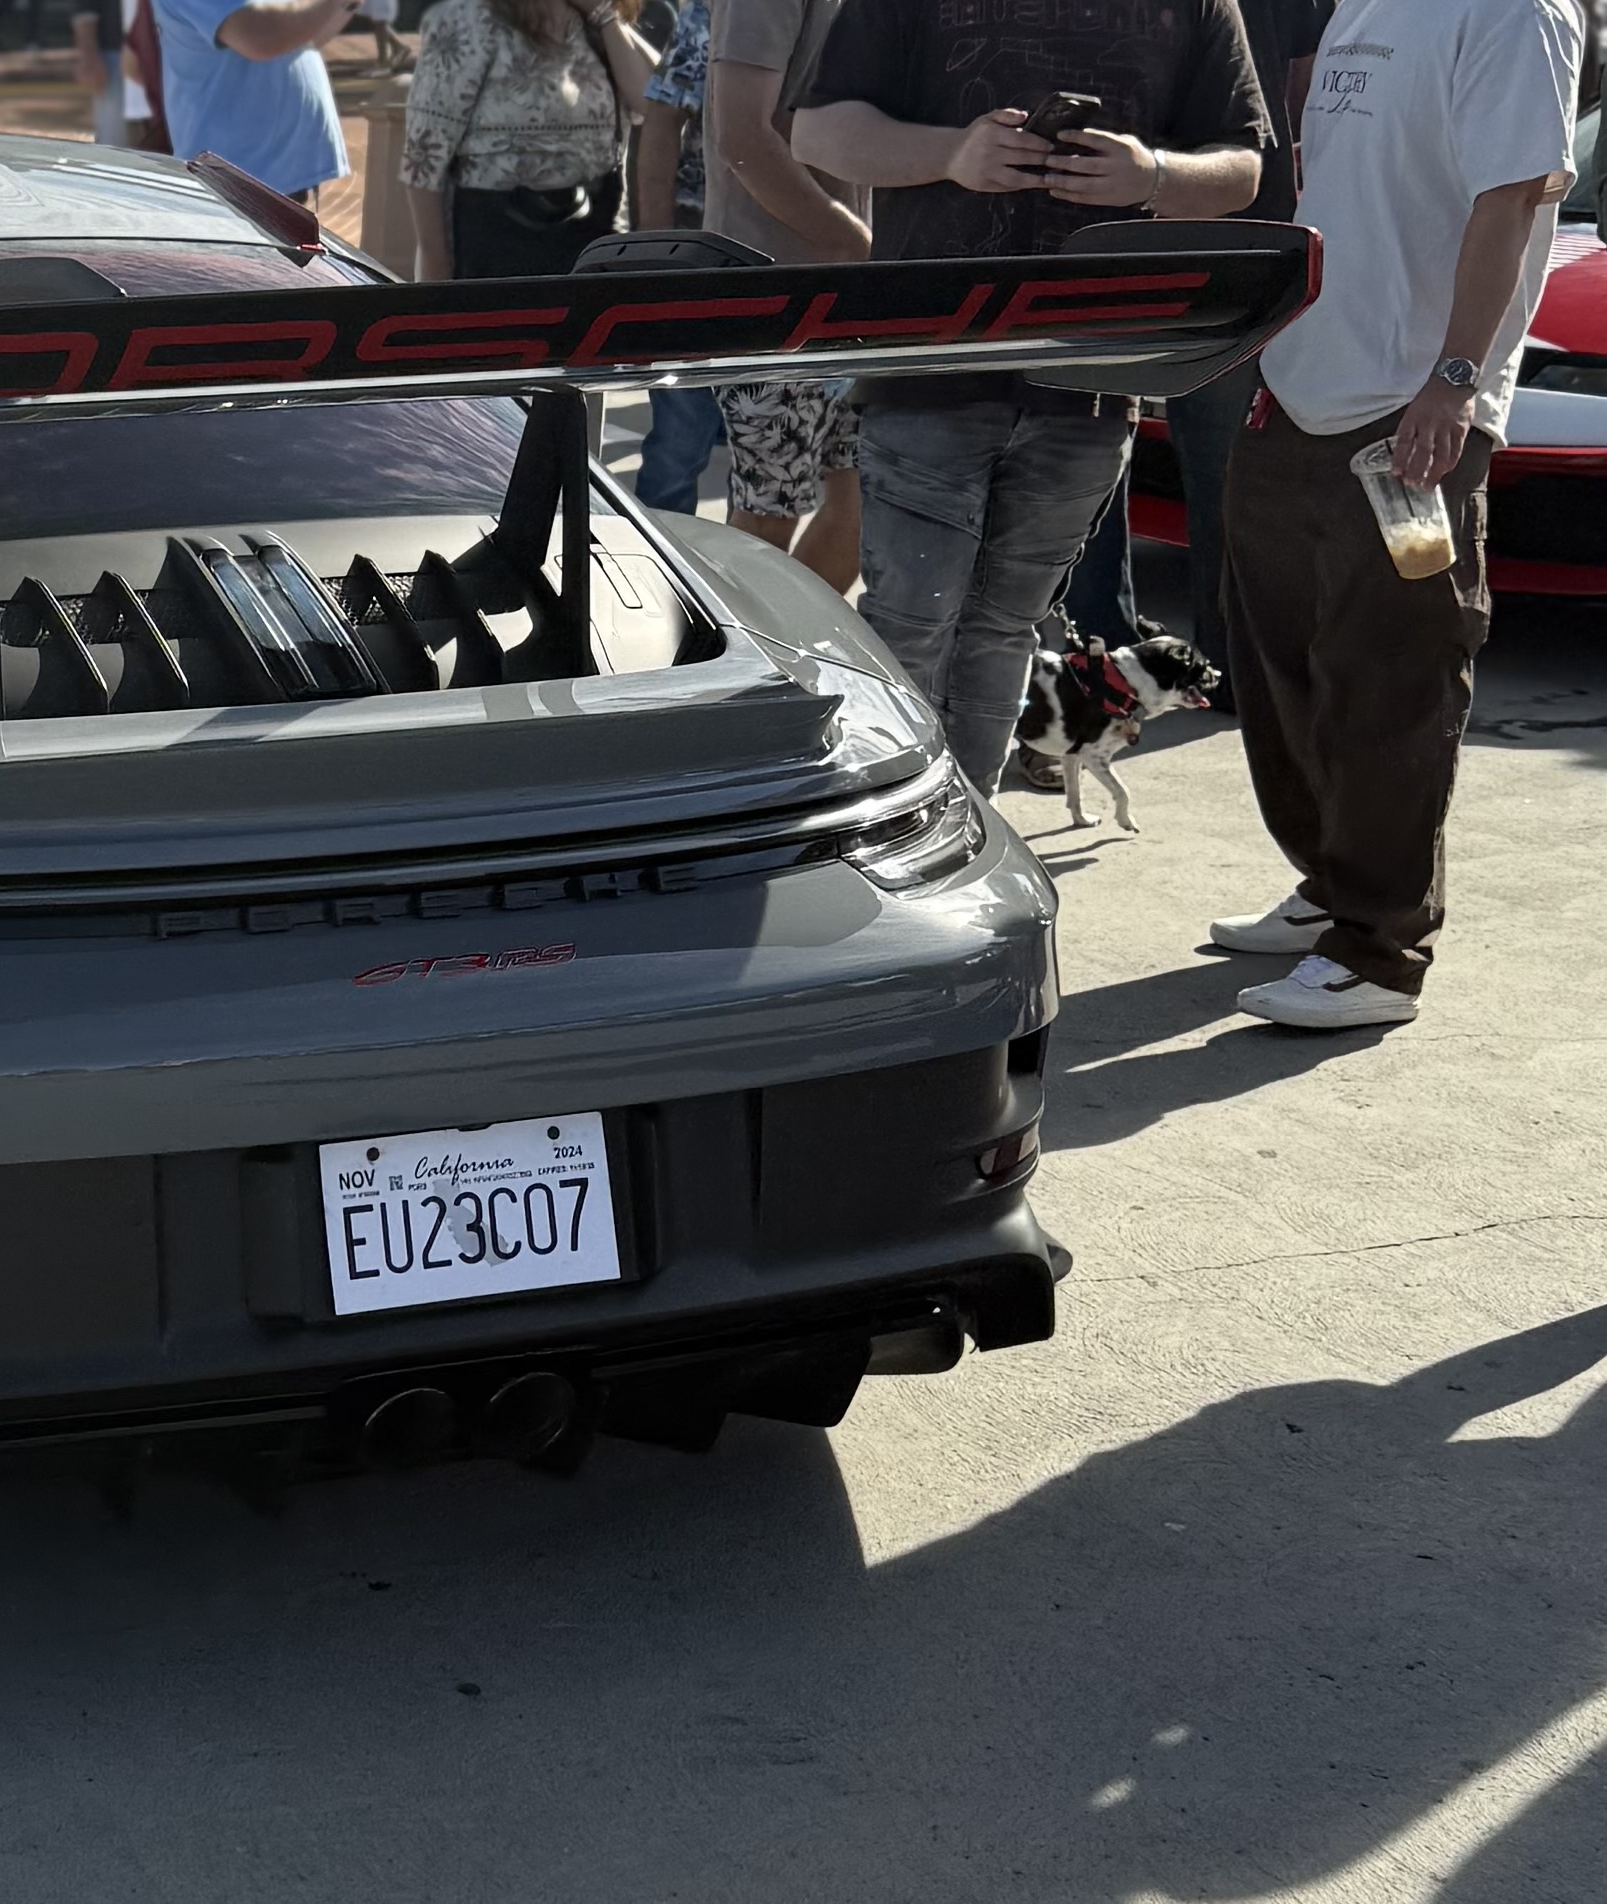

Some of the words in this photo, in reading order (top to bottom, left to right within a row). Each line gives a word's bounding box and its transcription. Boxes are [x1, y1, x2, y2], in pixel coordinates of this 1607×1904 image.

[339, 1169, 375, 1191] NOV
[414, 1153, 515, 1186] California
[554, 1145, 583, 1159] 2024
